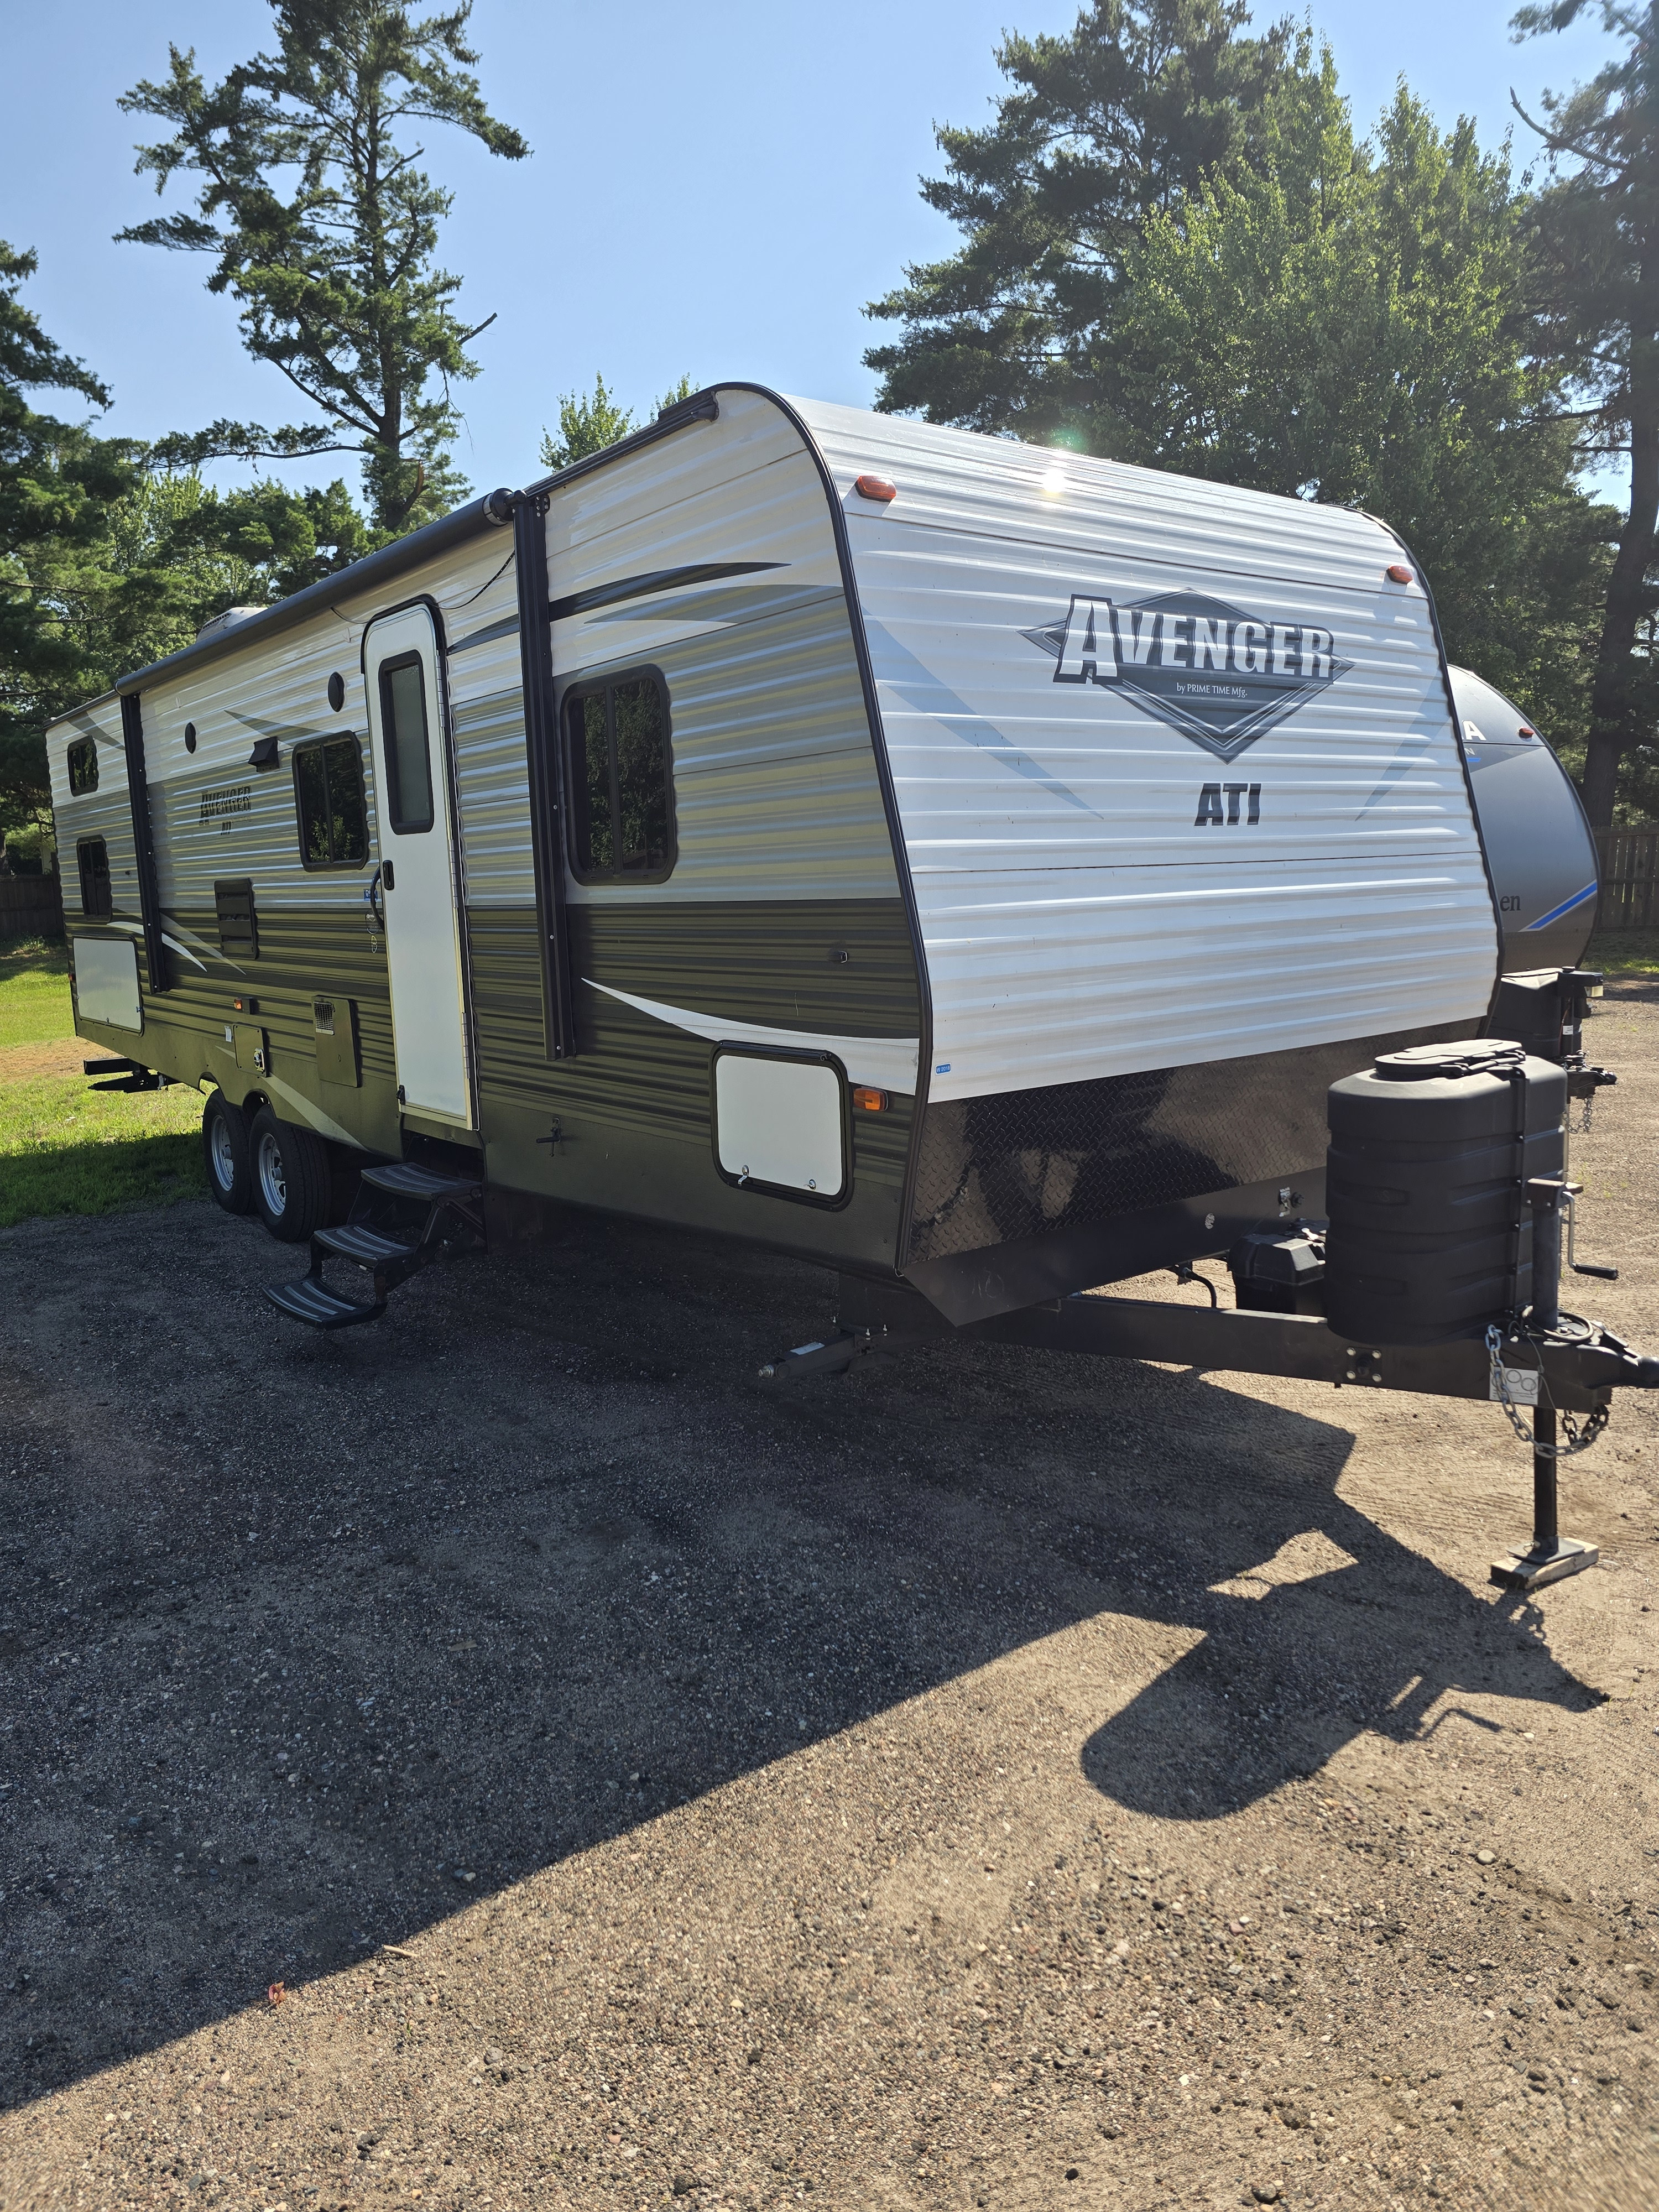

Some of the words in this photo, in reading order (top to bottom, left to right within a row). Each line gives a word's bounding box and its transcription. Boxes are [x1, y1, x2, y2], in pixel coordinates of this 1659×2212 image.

[1053, 594, 1334, 685] AVENGER
[1177, 682, 1185, 694] by
[1187, 684, 1211, 693] PRIME
[1212, 686, 1230, 695] TIME
[1232, 687, 1248, 698] Mfg.
[1461, 720, 1486, 741] A
[199, 785, 252, 826] AVENGER
[1194, 783, 1261, 826] ATI
